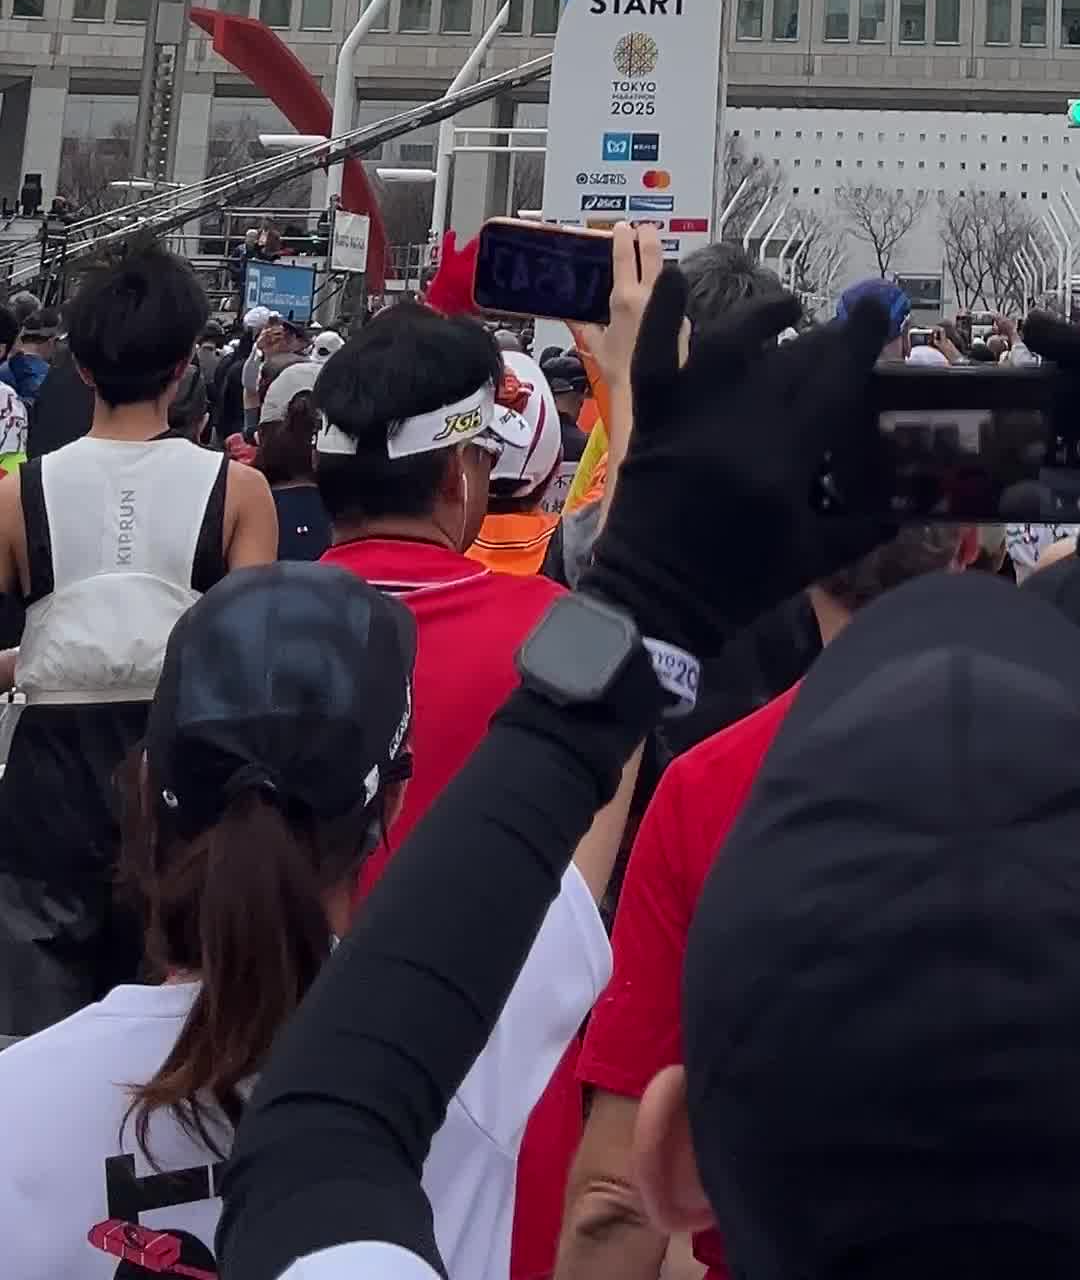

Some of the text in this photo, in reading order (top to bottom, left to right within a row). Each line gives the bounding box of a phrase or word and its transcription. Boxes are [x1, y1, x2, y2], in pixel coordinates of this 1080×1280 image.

[612, 81, 657, 93] TOKYO
[610, 102, 656, 116] 2025
[116, 490, 136, 566] KIPRUN
